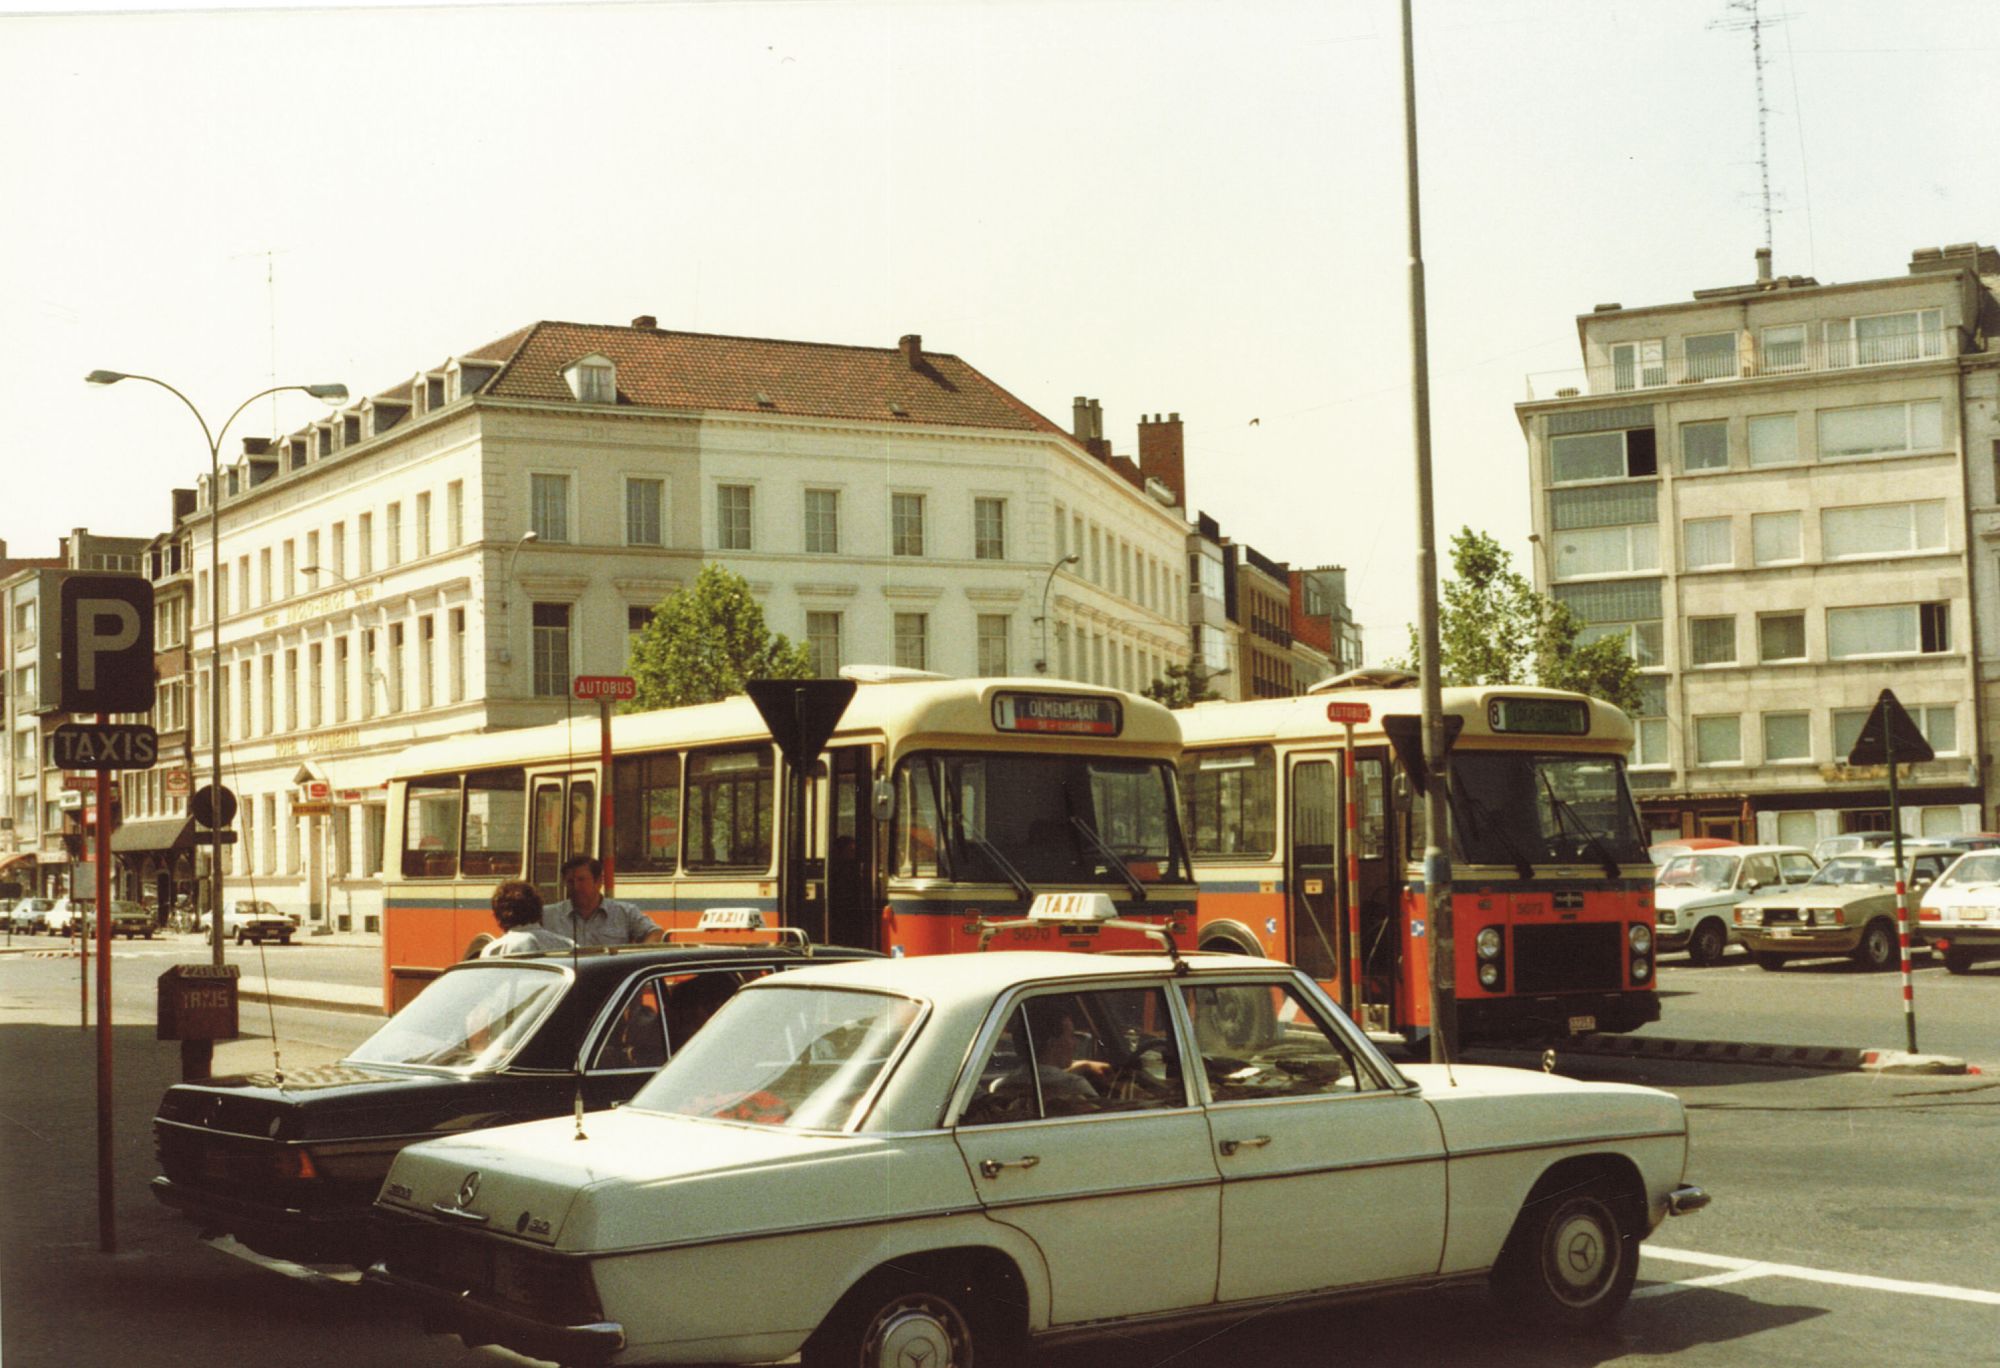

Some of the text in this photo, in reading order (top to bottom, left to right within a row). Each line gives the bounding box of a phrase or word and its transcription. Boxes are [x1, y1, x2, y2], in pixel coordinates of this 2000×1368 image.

[76, 598, 141, 691] P
[577, 681, 633, 695] AUTOBUS
[1329, 708, 1369, 720] AUTOBUS
[1491, 703, 1500, 725] 8
[59, 730, 154, 763] TAXIS
[1044, 895, 1084, 913] TAXI
